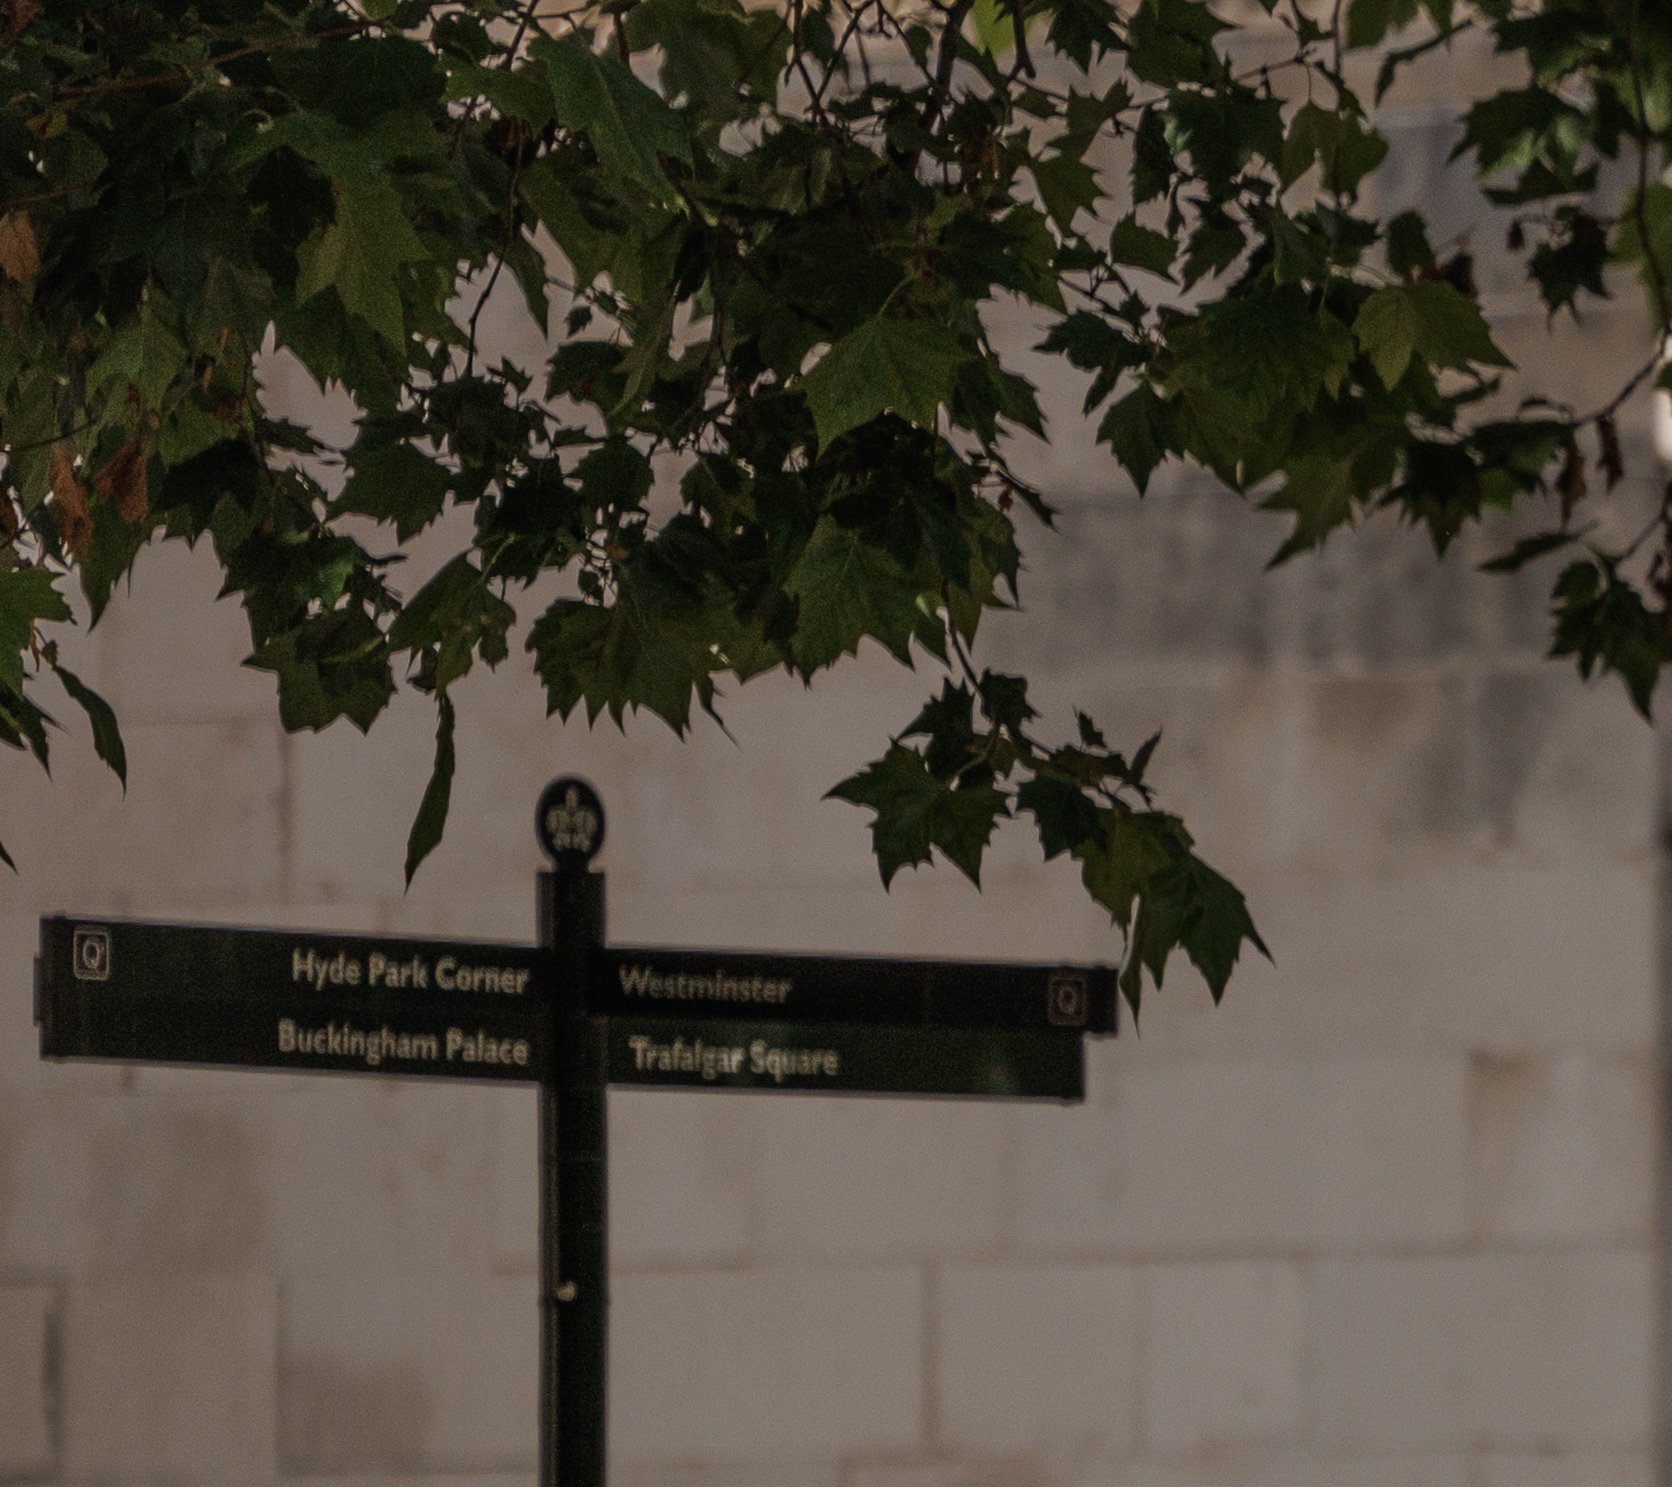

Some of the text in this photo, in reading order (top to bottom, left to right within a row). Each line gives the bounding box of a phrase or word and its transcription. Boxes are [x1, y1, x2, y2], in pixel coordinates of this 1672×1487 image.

[291, 948, 530, 995] Hyde Park Corner
[618, 964, 793, 1004] Westminster
[278, 1017, 529, 1066] Buckingham Palace
[628, 1035, 839, 1083] Trafalgar Square
